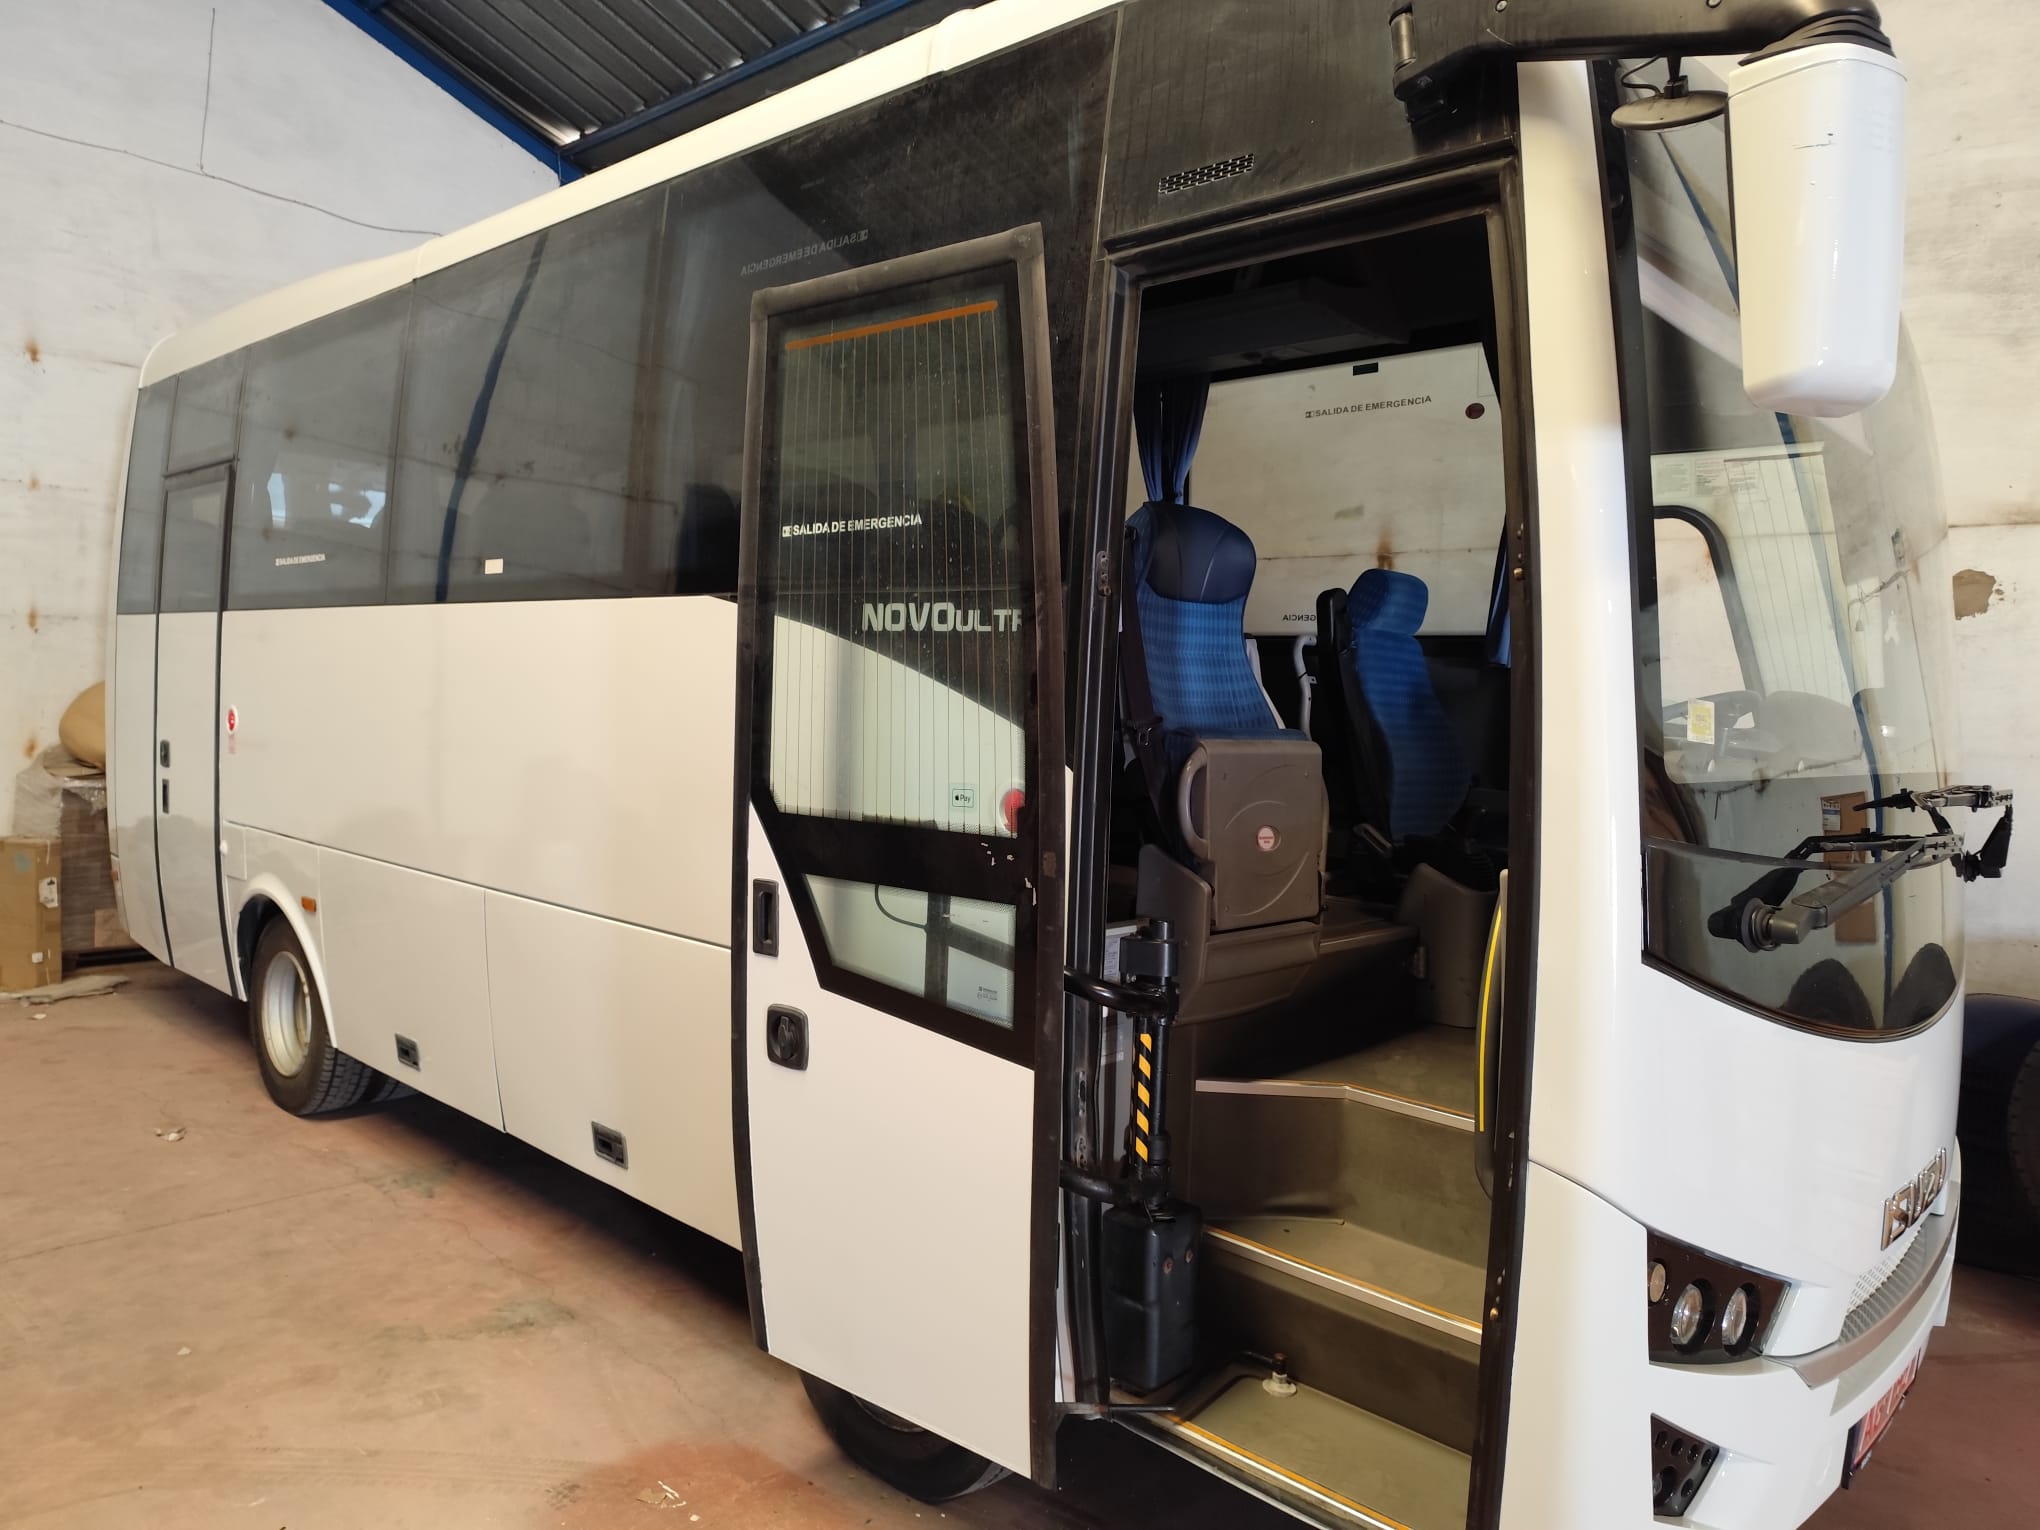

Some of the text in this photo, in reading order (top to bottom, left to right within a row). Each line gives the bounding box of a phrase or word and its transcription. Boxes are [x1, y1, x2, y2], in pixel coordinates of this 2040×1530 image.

[1315, 395, 1432, 417] SALIDA DE EMERGENCIA
[793, 513, 922, 536] SALIDA DE EMERGENCIA
